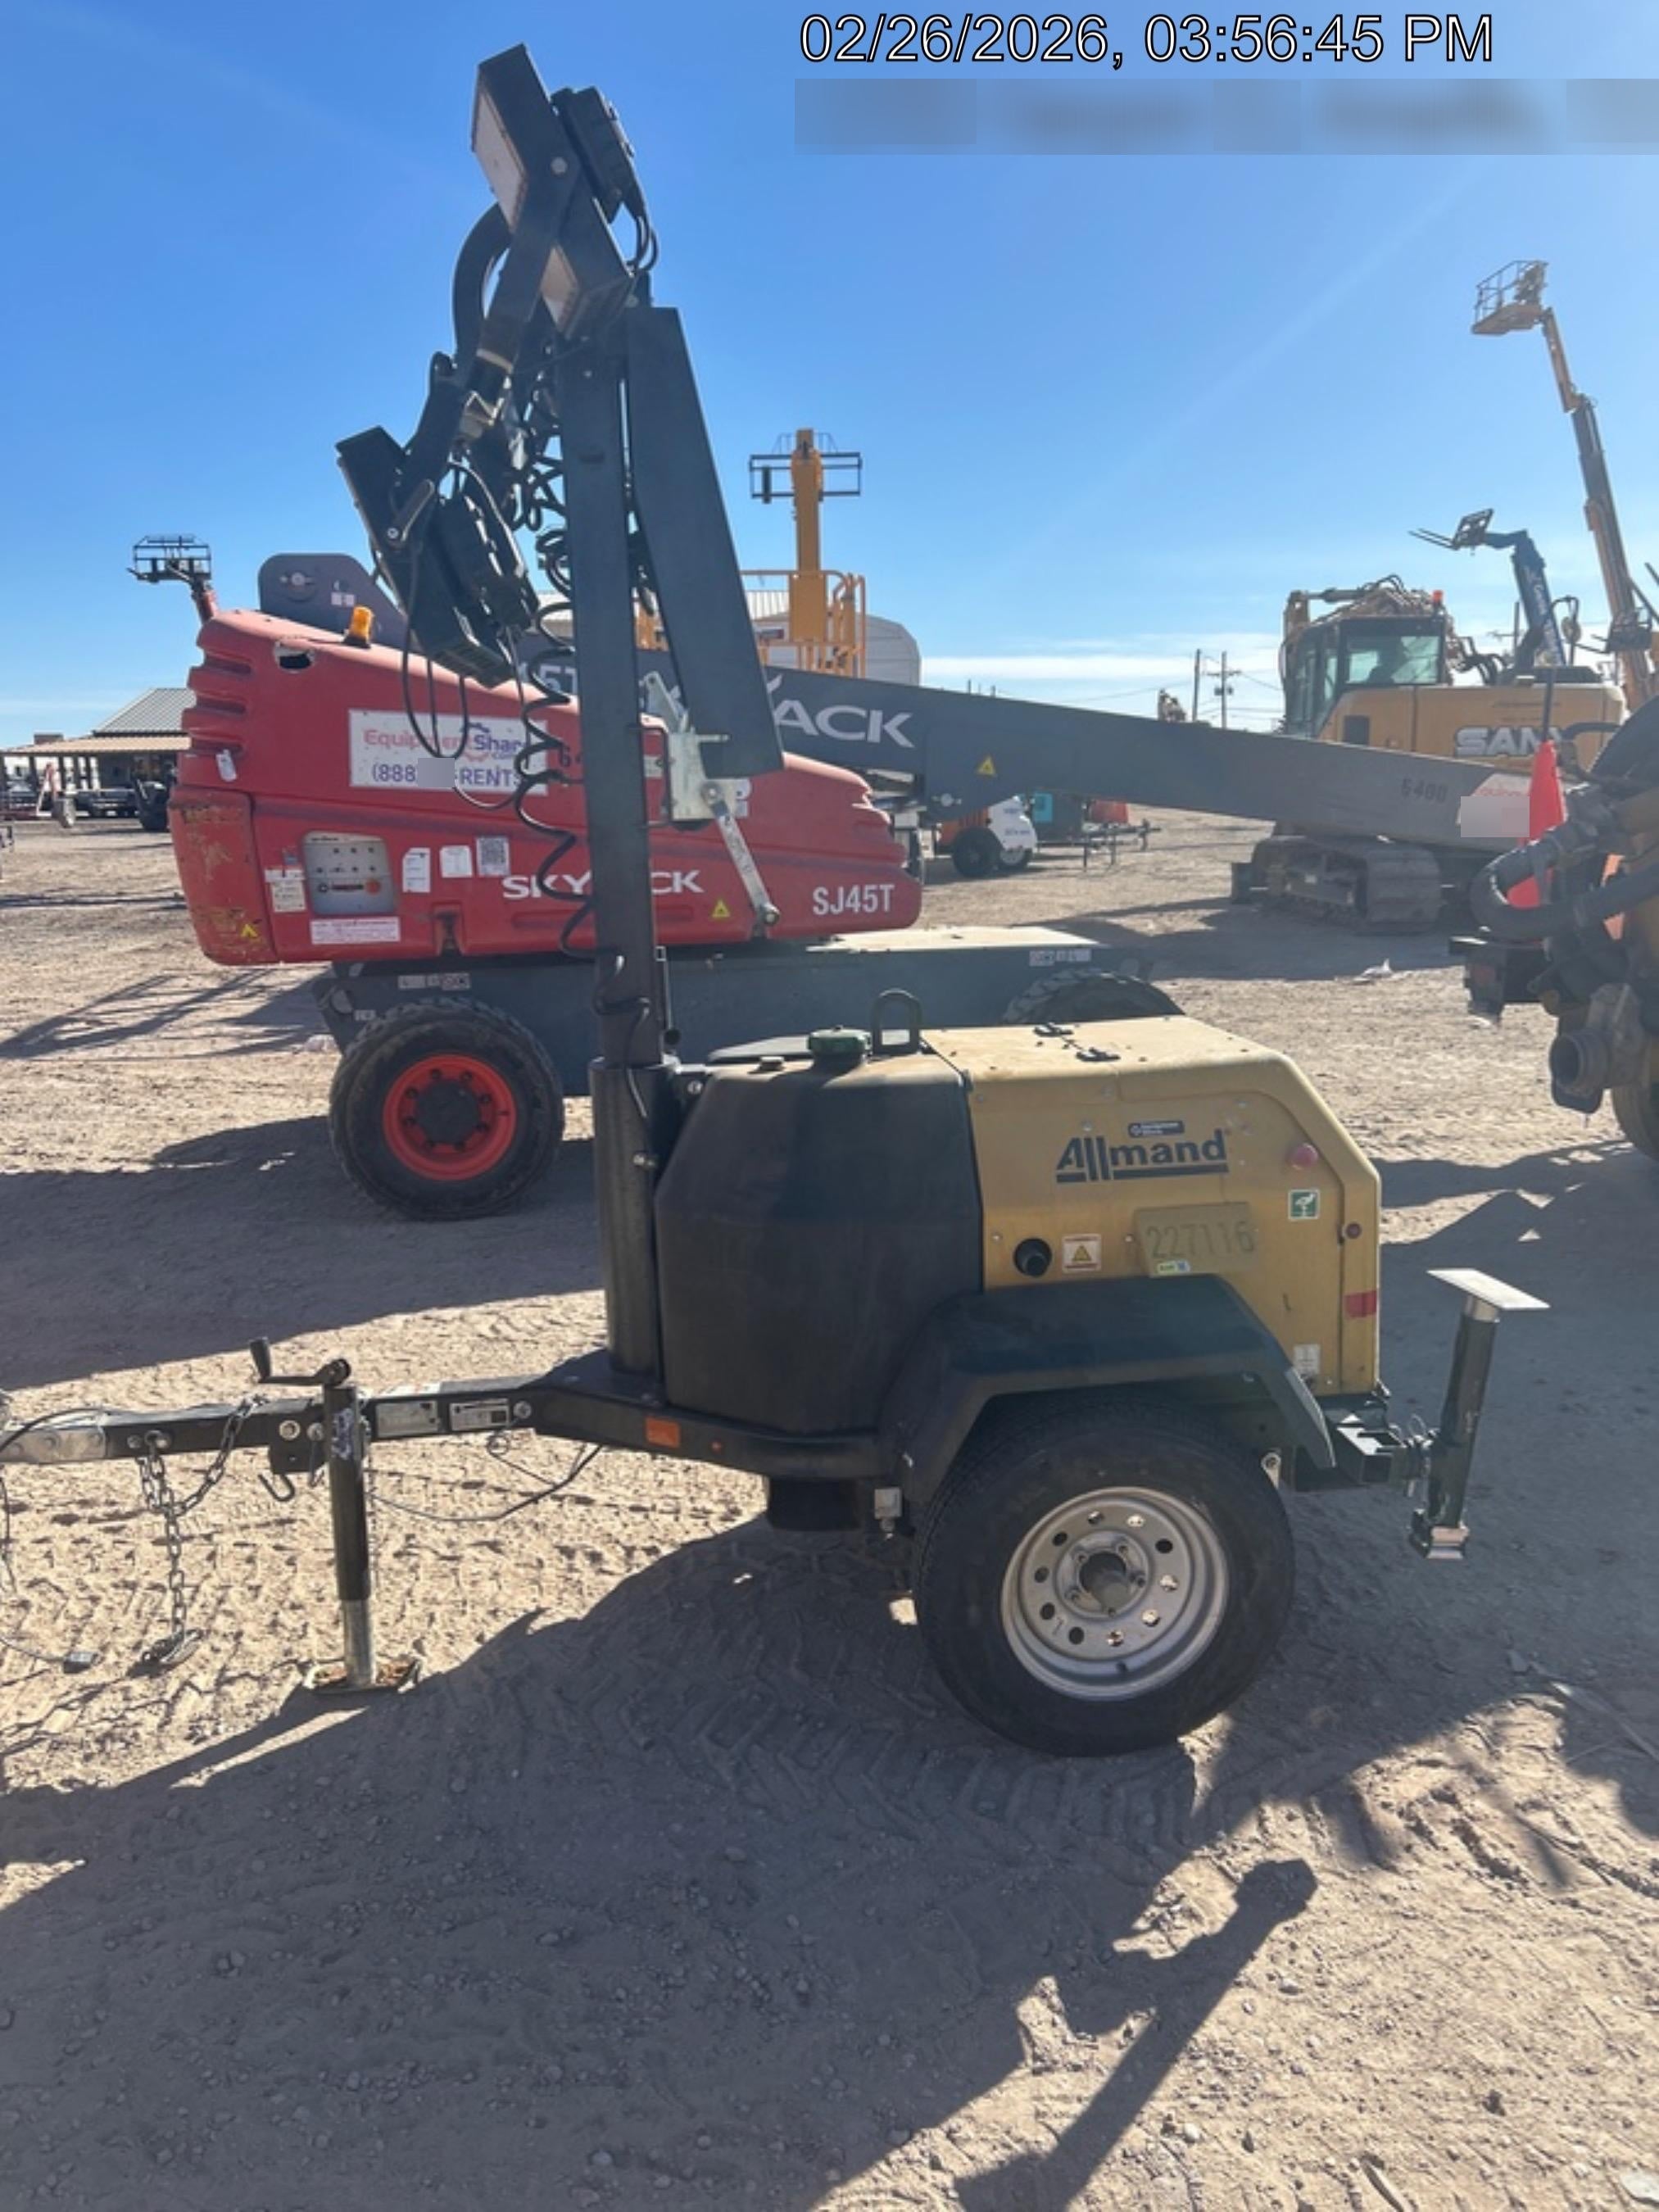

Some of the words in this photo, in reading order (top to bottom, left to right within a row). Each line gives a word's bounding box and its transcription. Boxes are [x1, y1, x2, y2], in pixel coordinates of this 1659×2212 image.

[373, 763, 419, 782] (888
[501, 869, 704, 899] SKYCK
[812, 883, 895, 915] SJ45T
[1056, 1128, 1227, 1181] Allmand
